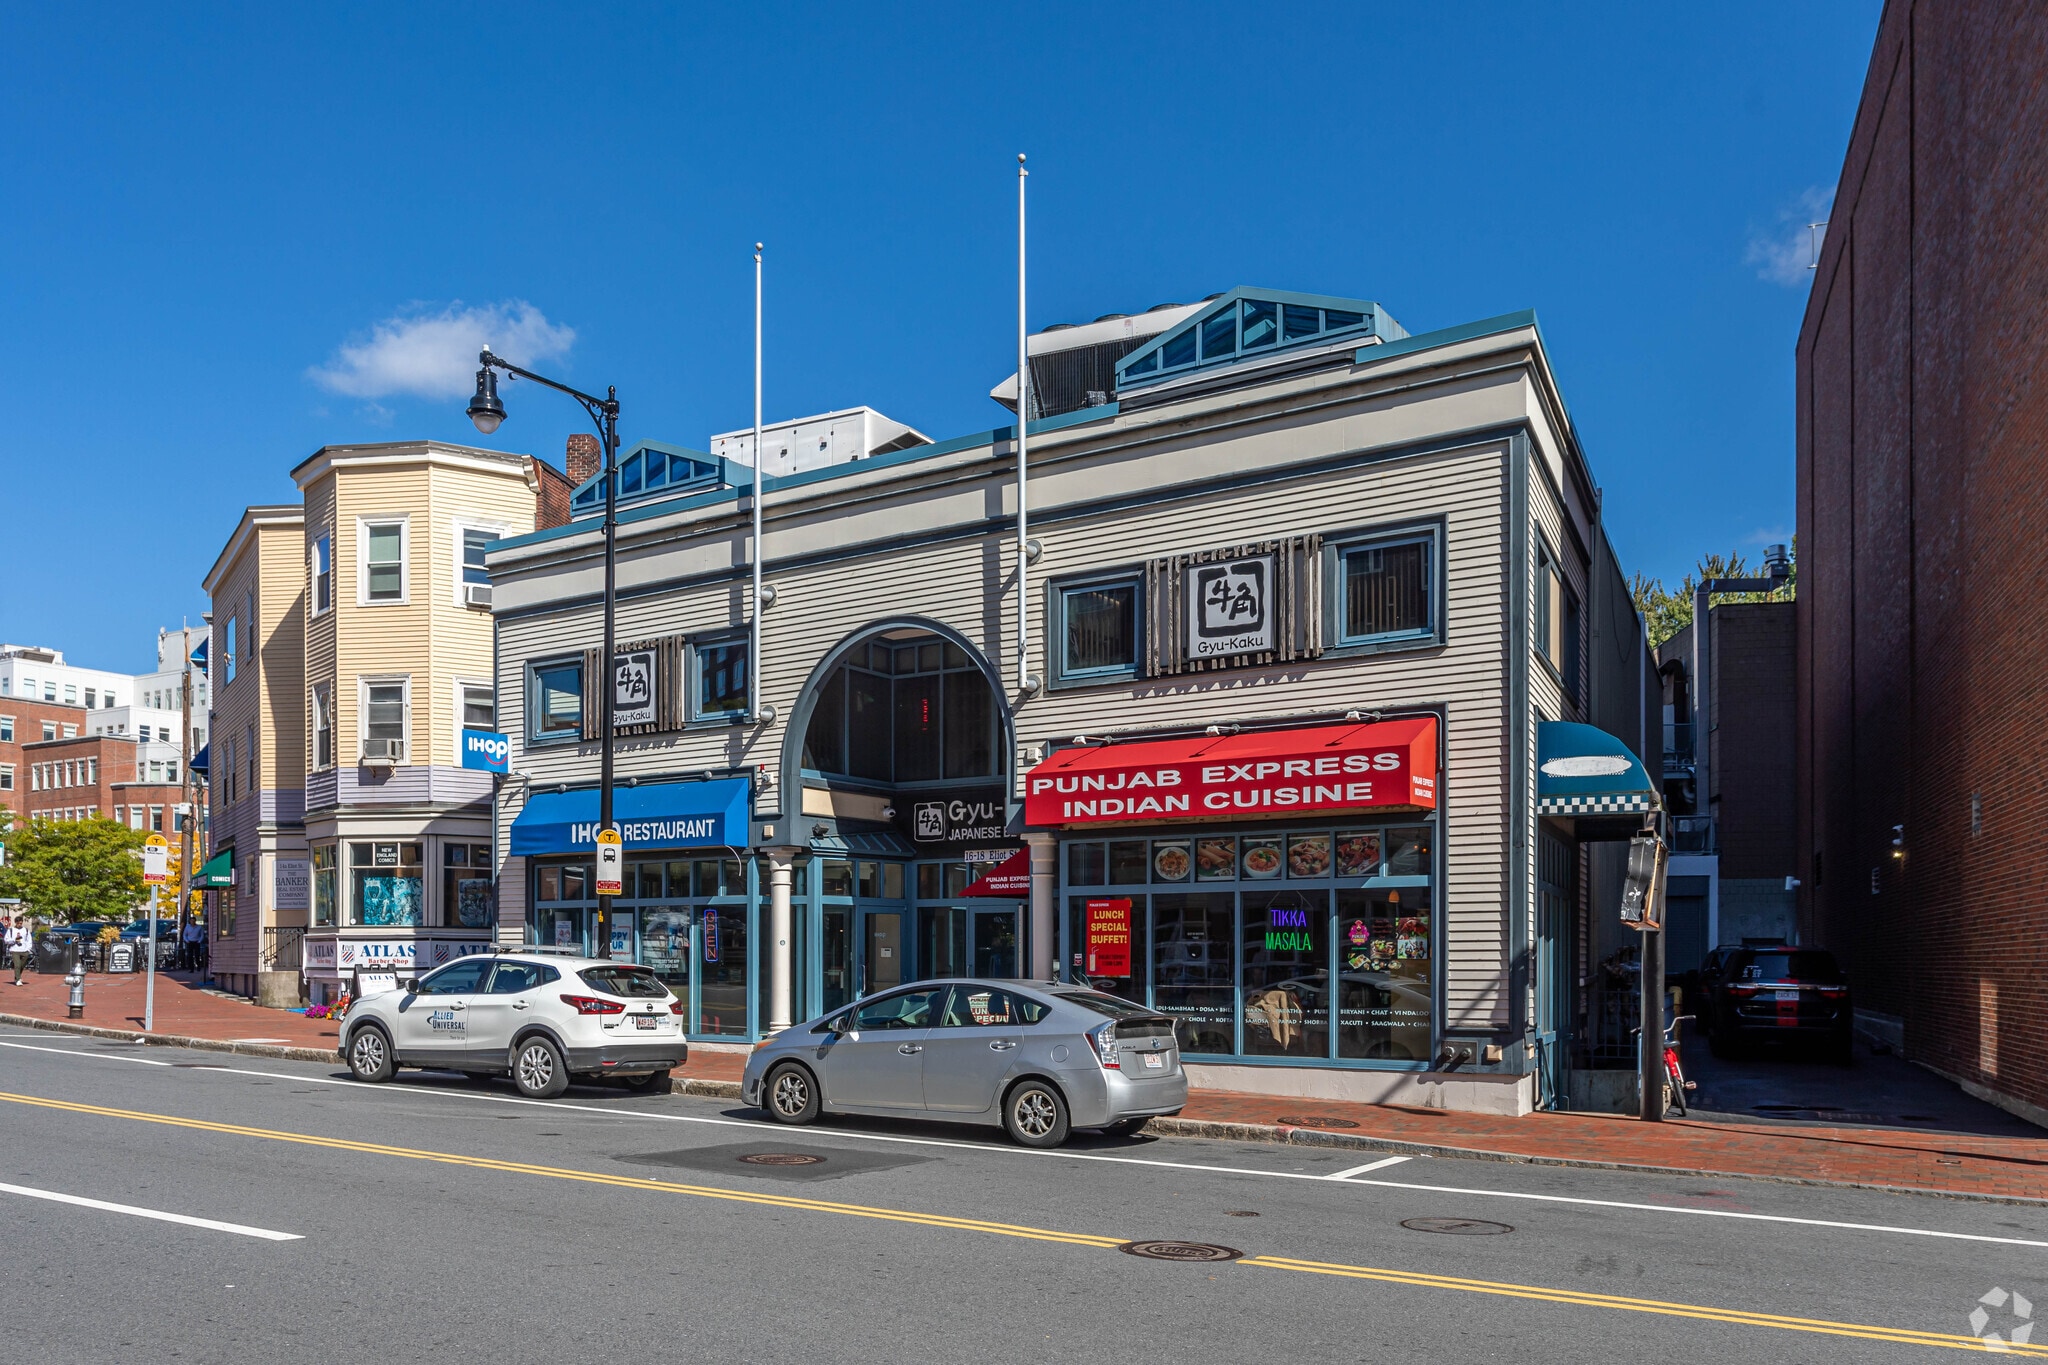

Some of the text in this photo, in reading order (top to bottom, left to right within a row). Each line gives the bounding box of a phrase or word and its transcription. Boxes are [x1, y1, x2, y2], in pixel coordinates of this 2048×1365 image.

[1198, 636, 1264, 654] Gyu-Kaku
[1033, 752, 1401, 795] PUNJAB EXPRESS
[1064, 782, 1373, 818] INDIAN CUISINE
[948, 800, 1005, 825] Gyu-
[624, 819, 715, 842] RESTAURANT
[948, 826, 1001, 840] JAPANESE
[965, 851, 984, 861] 16-18
[989, 850, 1006, 860] Eliot
[276, 877, 309, 886] BANKER
[1094, 910, 1124, 919] LUNCH
[1271, 909, 1306, 927] TIKKA
[1091, 923, 1127, 932] SPECIAL
[612, 932, 627, 940] PPY
[706, 912, 717, 959] OPEN
[1091, 935, 1127, 944] BUFFET!
[1266, 932, 1312, 950] MASALA
[313, 945, 334, 957] ATLAS
[360, 945, 417, 957] ATLAS
[612, 940, 624, 950] UR
[433, 1010, 454, 1020] ALLIED
[433, 1020, 465, 1030] UNIVERSAL
